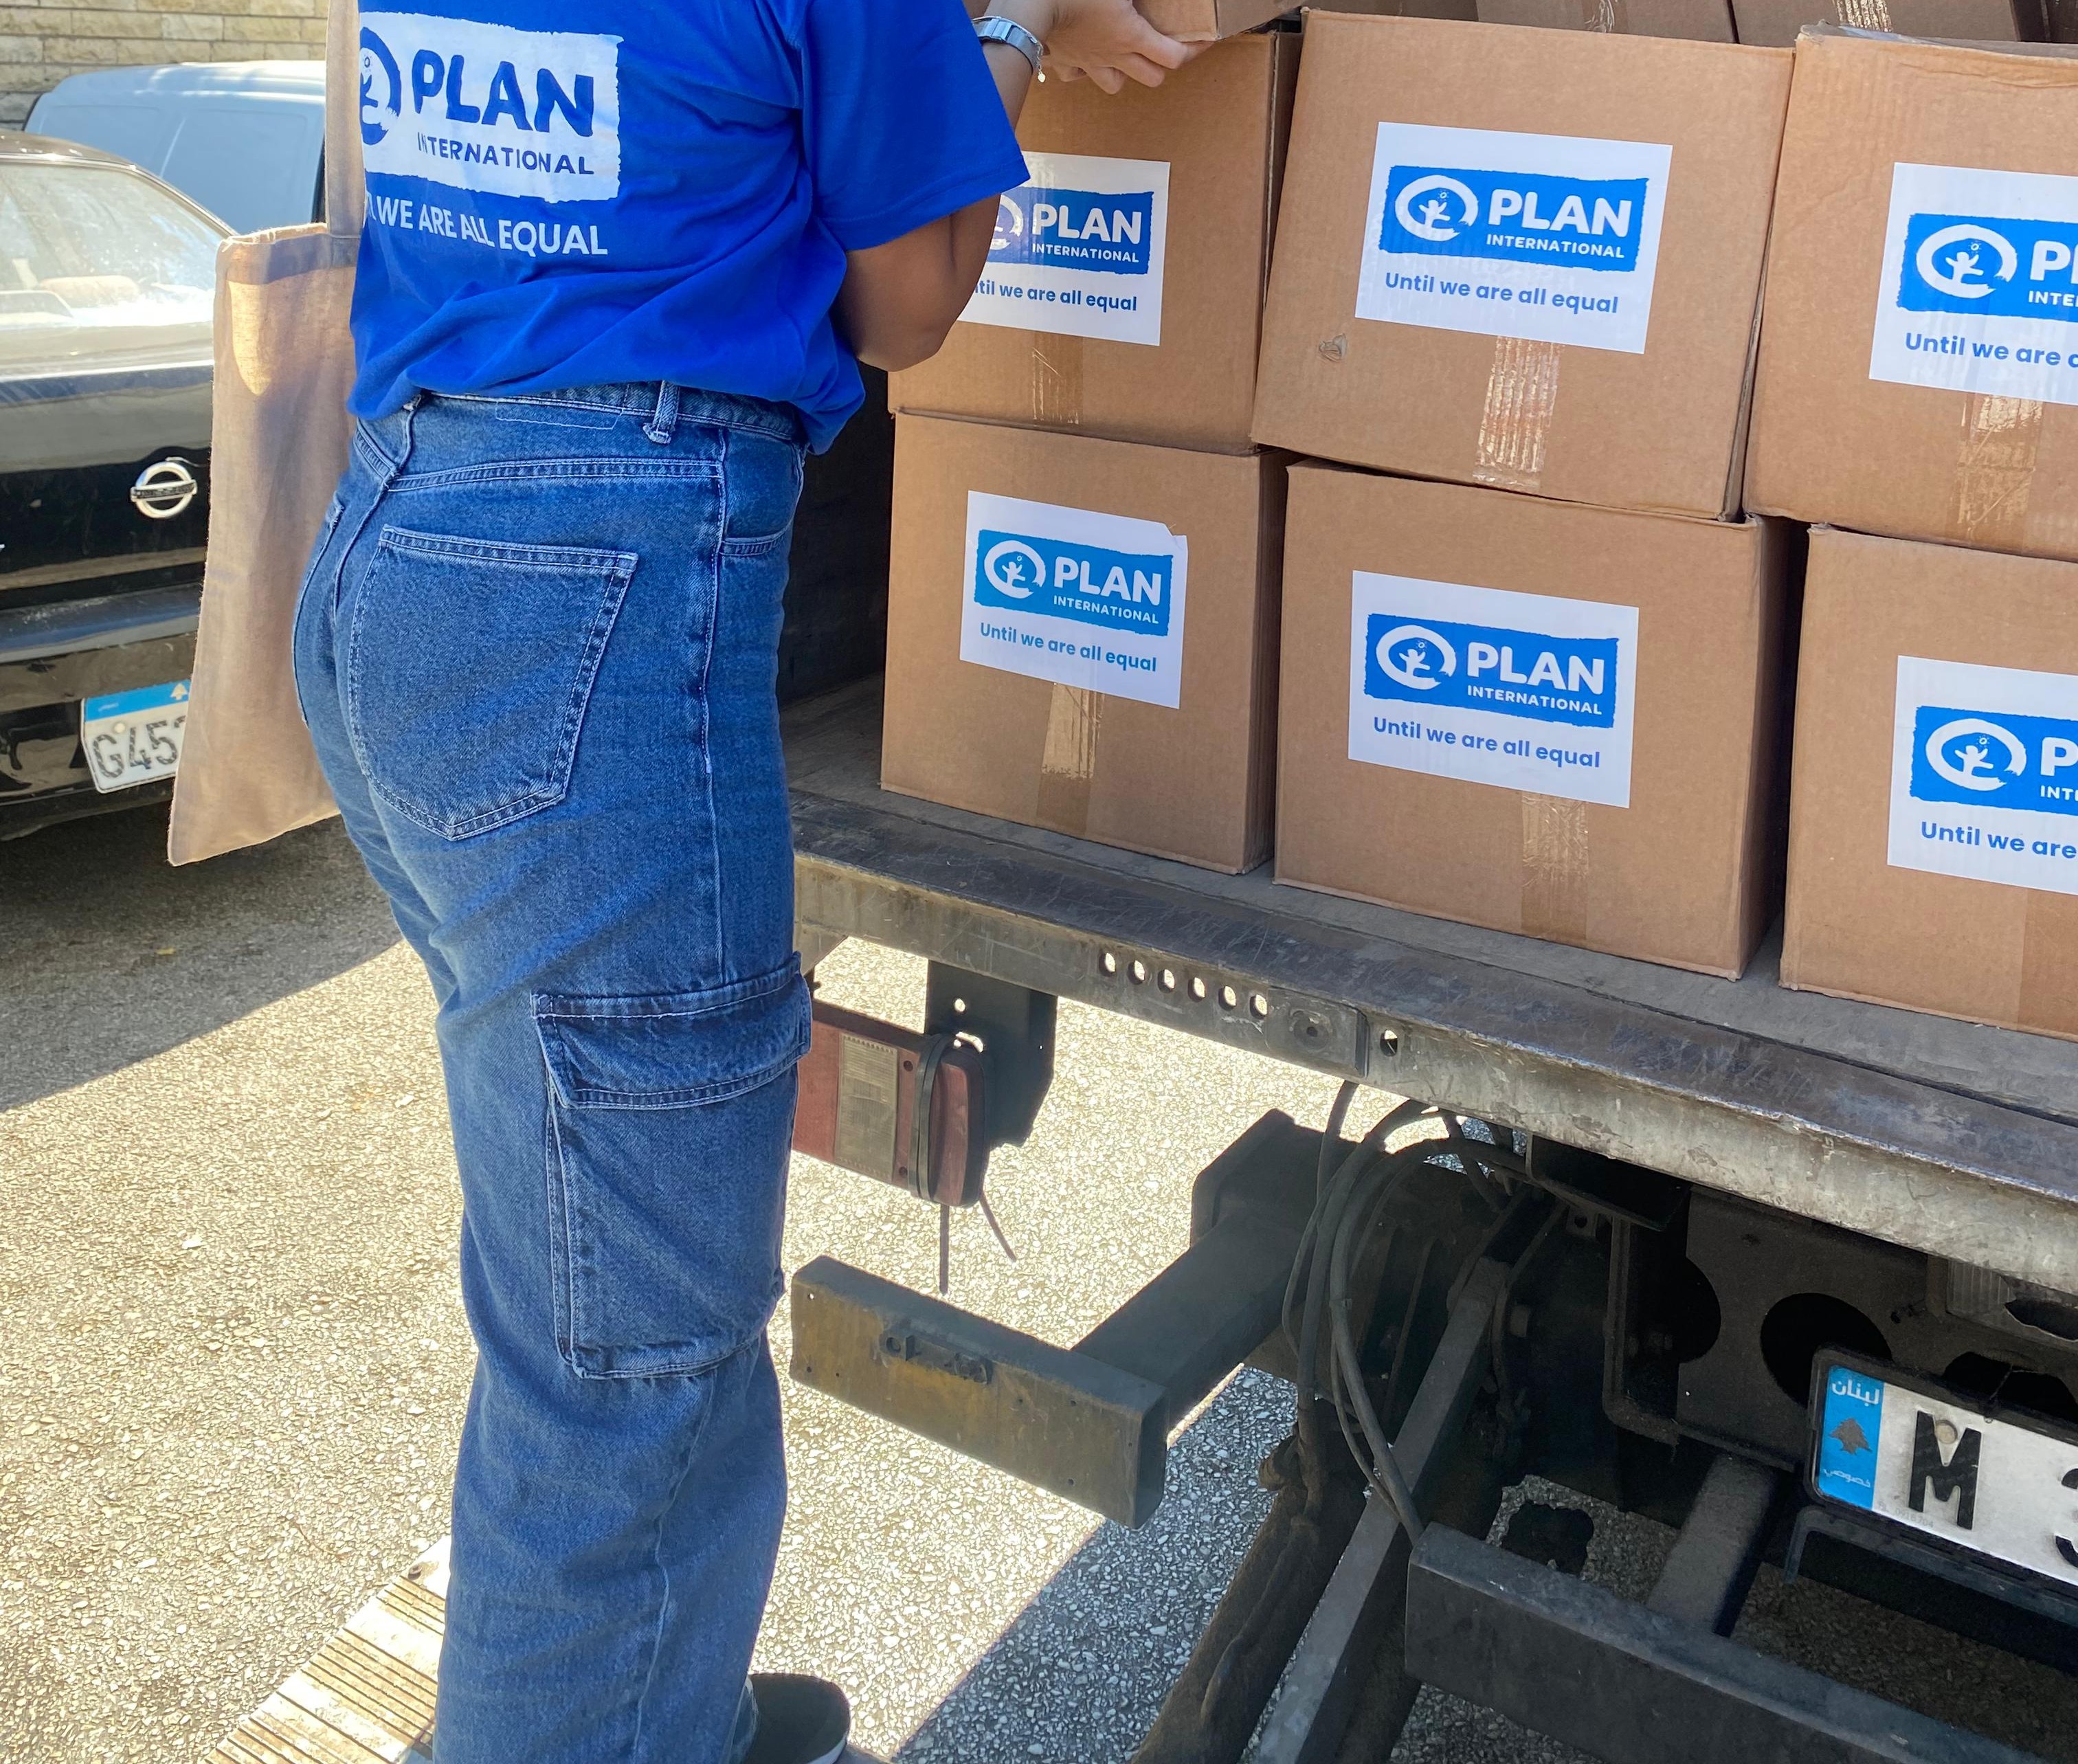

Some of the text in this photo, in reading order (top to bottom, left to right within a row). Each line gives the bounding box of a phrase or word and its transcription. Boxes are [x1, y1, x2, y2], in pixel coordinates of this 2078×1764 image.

[412, 49, 594, 137] PLAN
[418, 132, 594, 175] INTERNATIONAL
[376, 195, 414, 230] WE
[418, 203, 458, 239] ARE
[461, 214, 495, 248] ALL
[498, 220, 608, 257] EQUAL
[1032, 203, 1142, 245] PLAN
[1488, 189, 1633, 238] PLAN
[1032, 243, 1139, 263] INTERNATIONAL
[1486, 234, 1625, 258] INTERNATIONAL
[2030, 240, 2078, 284] P
[999, 285, 1023, 298] we
[1027, 289, 1056, 302] are
[1060, 291, 1082, 305] all
[1086, 295, 1137, 313] equal
[1385, 272, 1619, 315] Until we are all equal
[2029, 290, 2078, 308] INTE
[1906, 333, 1965, 355] Until
[1972, 342, 2009, 361] we
[2016, 348, 2061, 366] are
[1053, 556, 1162, 605] PLAN
[1053, 595, 1159, 624] INTERNATIONAL
[981, 622, 1157, 672] Until we are all equal
[1466, 642, 1605, 695] PLAN
[1467, 684, 1602, 715] INTERNATIONAL
[1374, 717, 1600, 768] Until we are all equal
[1921, 821, 2077, 860] Until we are
[1831, 1378, 1880, 1407] لبنان
[1822, 1467, 1871, 1488] خصوصي
[1908, 1409, 1982, 1531] M
